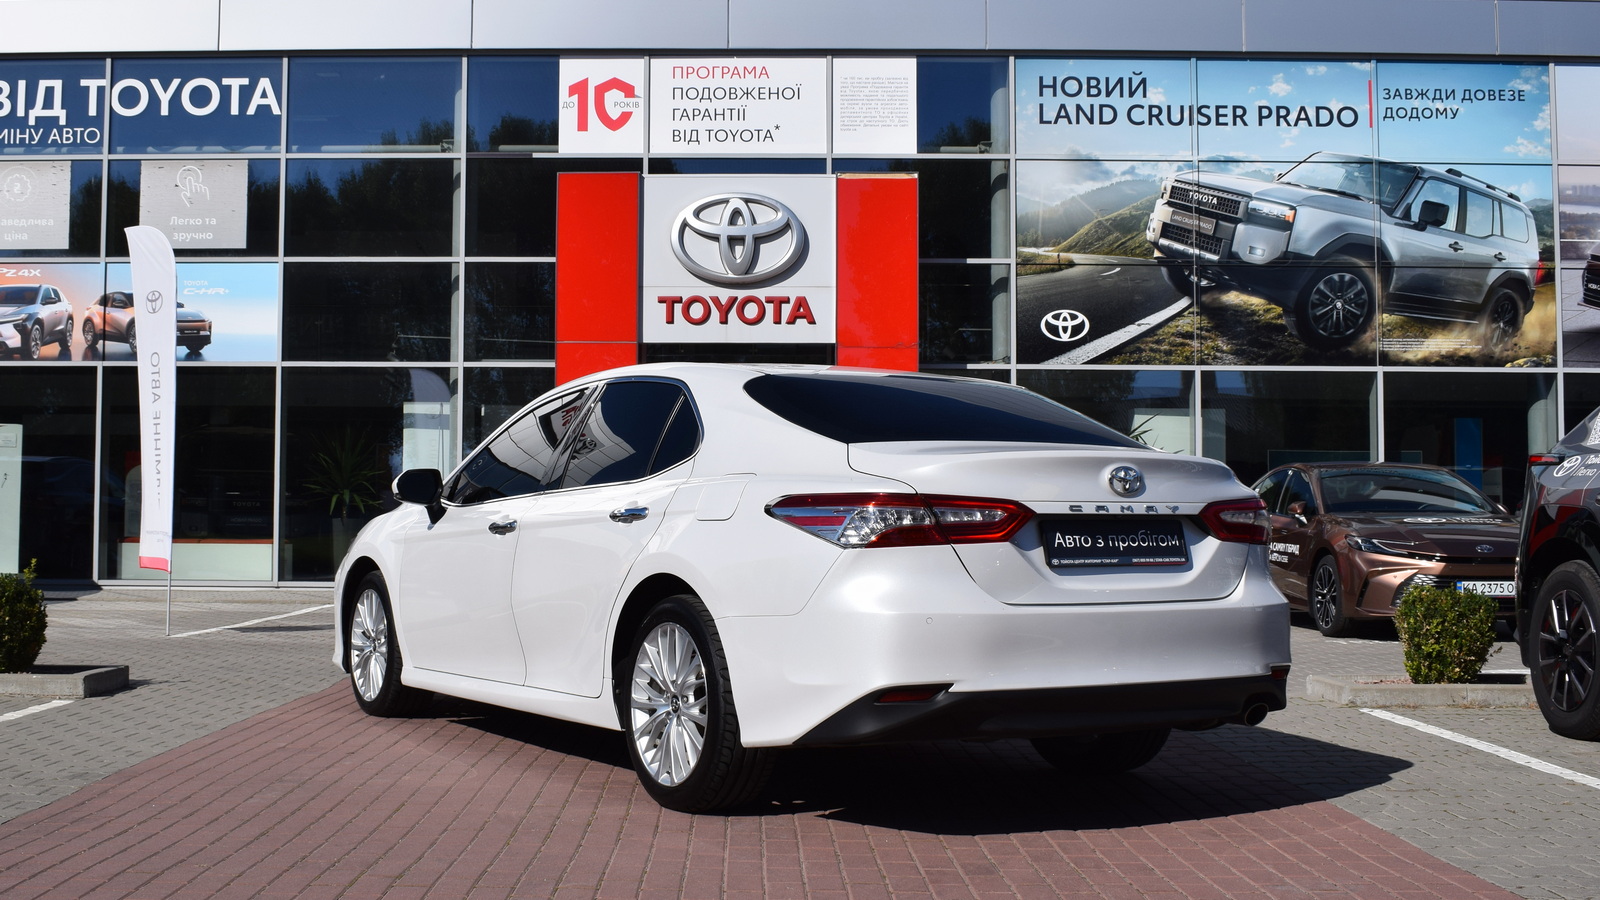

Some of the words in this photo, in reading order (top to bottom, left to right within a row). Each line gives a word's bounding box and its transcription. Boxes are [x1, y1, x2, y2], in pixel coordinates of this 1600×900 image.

[672, 65, 770, 80] ПРОГРАМА
[1038, 71, 1147, 98] НОВИЙ
[80, 77, 282, 117] TOYOTA
[672, 83, 802, 103] ПОДОВЖЕНОЇ
[1383, 88, 1457, 103] ЗАВЖДИ
[1461, 90, 1526, 104] ДОВЕЗЕ
[562, 101, 575, 110] ДО
[613, 101, 640, 109] РОКІВ
[672, 104, 748, 122] ГАРАНТІЇ
[1038, 103, 1118, 125] LAND
[1126, 104, 1249, 127] CRUISER
[1257, 105, 1359, 128] PRADO
[1383, 106, 1460, 122] ДОДОМУ
[48, 127, 100, 144] АВТО
[672, 129, 700, 145] ВІД
[1189, 191, 1218, 205] TOYOTA
[170, 216, 202, 226] Легко
[205, 218, 216, 226] та
[4, 231, 28, 242] ціна
[173, 230, 213, 241] зручно
[657, 295, 817, 325] TOYOTA
[1068, 504, 1180, 514] CAMRY
[1054, 532, 1092, 548] Авто
[1096, 535, 1105, 547] з
[1108, 530, 1180, 551] пробігом
[1481, 582, 1504, 594] 2375
